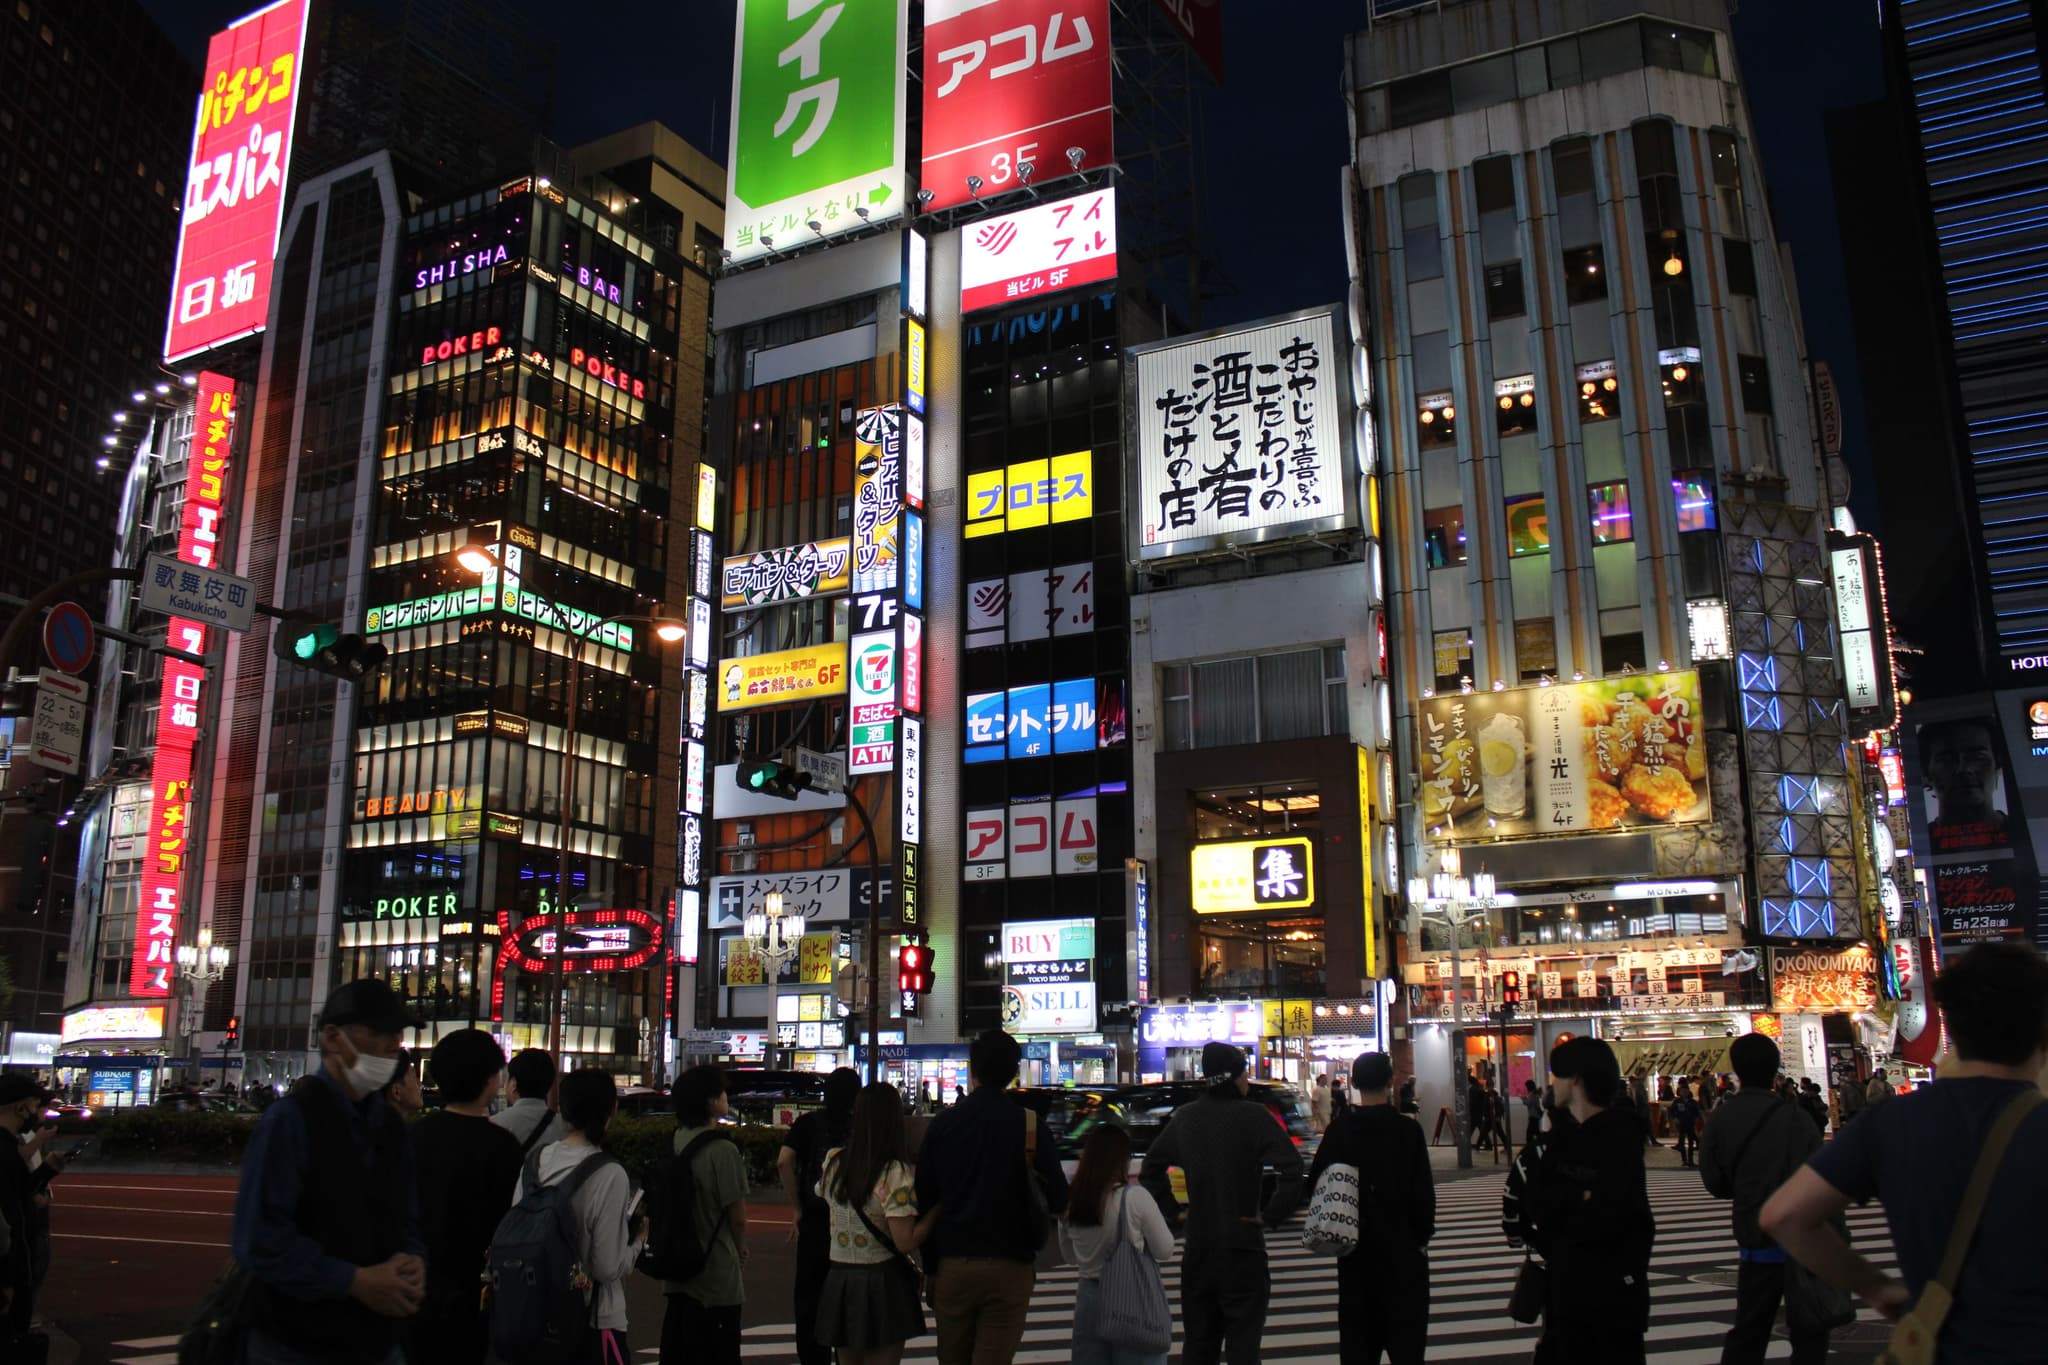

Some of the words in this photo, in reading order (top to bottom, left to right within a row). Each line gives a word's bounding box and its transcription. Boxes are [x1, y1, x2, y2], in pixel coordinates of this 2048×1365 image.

[937, 12, 1095, 98] アコム
[199, 53, 295, 136] パチンコ
[185, 123, 283, 226] エスパス
[990, 142, 1039, 184] 3F
[736, 191, 861, 249] 当ビルとなり
[1052, 195, 1103, 229] アイ
[1052, 231, 1107, 261] フル
[416, 244, 508, 289] SHISHA
[578, 266, 620, 304] BAR
[1006, 276, 1046, 297] 当ビル
[1050, 269, 1070, 287] 5F
[422, 326, 501, 363] POKER
[571, 348, 645, 399] POKER
[1191, 351, 1257, 520] 酒と肴
[1253, 364, 1290, 511] こだわりの
[1279, 337, 1321, 509] おやじが喜ぶ
[200, 392, 232, 500] パチンコ
[1155, 388, 1199, 532] だけの店
[976, 472, 1088, 516] プロミス
[155, 563, 248, 609] 歌舞伎町
[169, 594, 227, 620] Kabukicho
[858, 594, 897, 629] 7F
[817, 663, 841, 685] 6F
[906, 651, 918, 697] アコム
[1856, 682, 1868, 696] 光
[866, 725, 885, 743] 酒
[967, 702, 1096, 741] セントラル
[1615, 692, 1637, 753] チキンが
[855, 747, 893, 766] ATM
[1026, 743, 1040, 755] 4F
[1642, 716, 1669, 776] 猛烈に
[1426, 712, 1456, 830] レモンサワー
[1550, 757, 1569, 779] 光
[367, 788, 465, 817] BEAUTY
[1552, 810, 1574, 827] 4F
[157, 780, 188, 874] パチンコ
[968, 811, 1096, 860] アコム
[747, 875, 841, 898] メンズライフ
[976, 866, 995, 878] 3F
[1256, 848, 1304, 898] 集
[376, 894, 458, 920] POKER
[145, 887, 177, 989] エスパス
[1011, 933, 1057, 955] BUY
[1774, 954, 1877, 973] OKONOMIYAKI
[1031, 990, 1088, 1010] SELL
[1780, 974, 1869, 995] お好み焼き
[1289, 1006, 1309, 1030] 集
